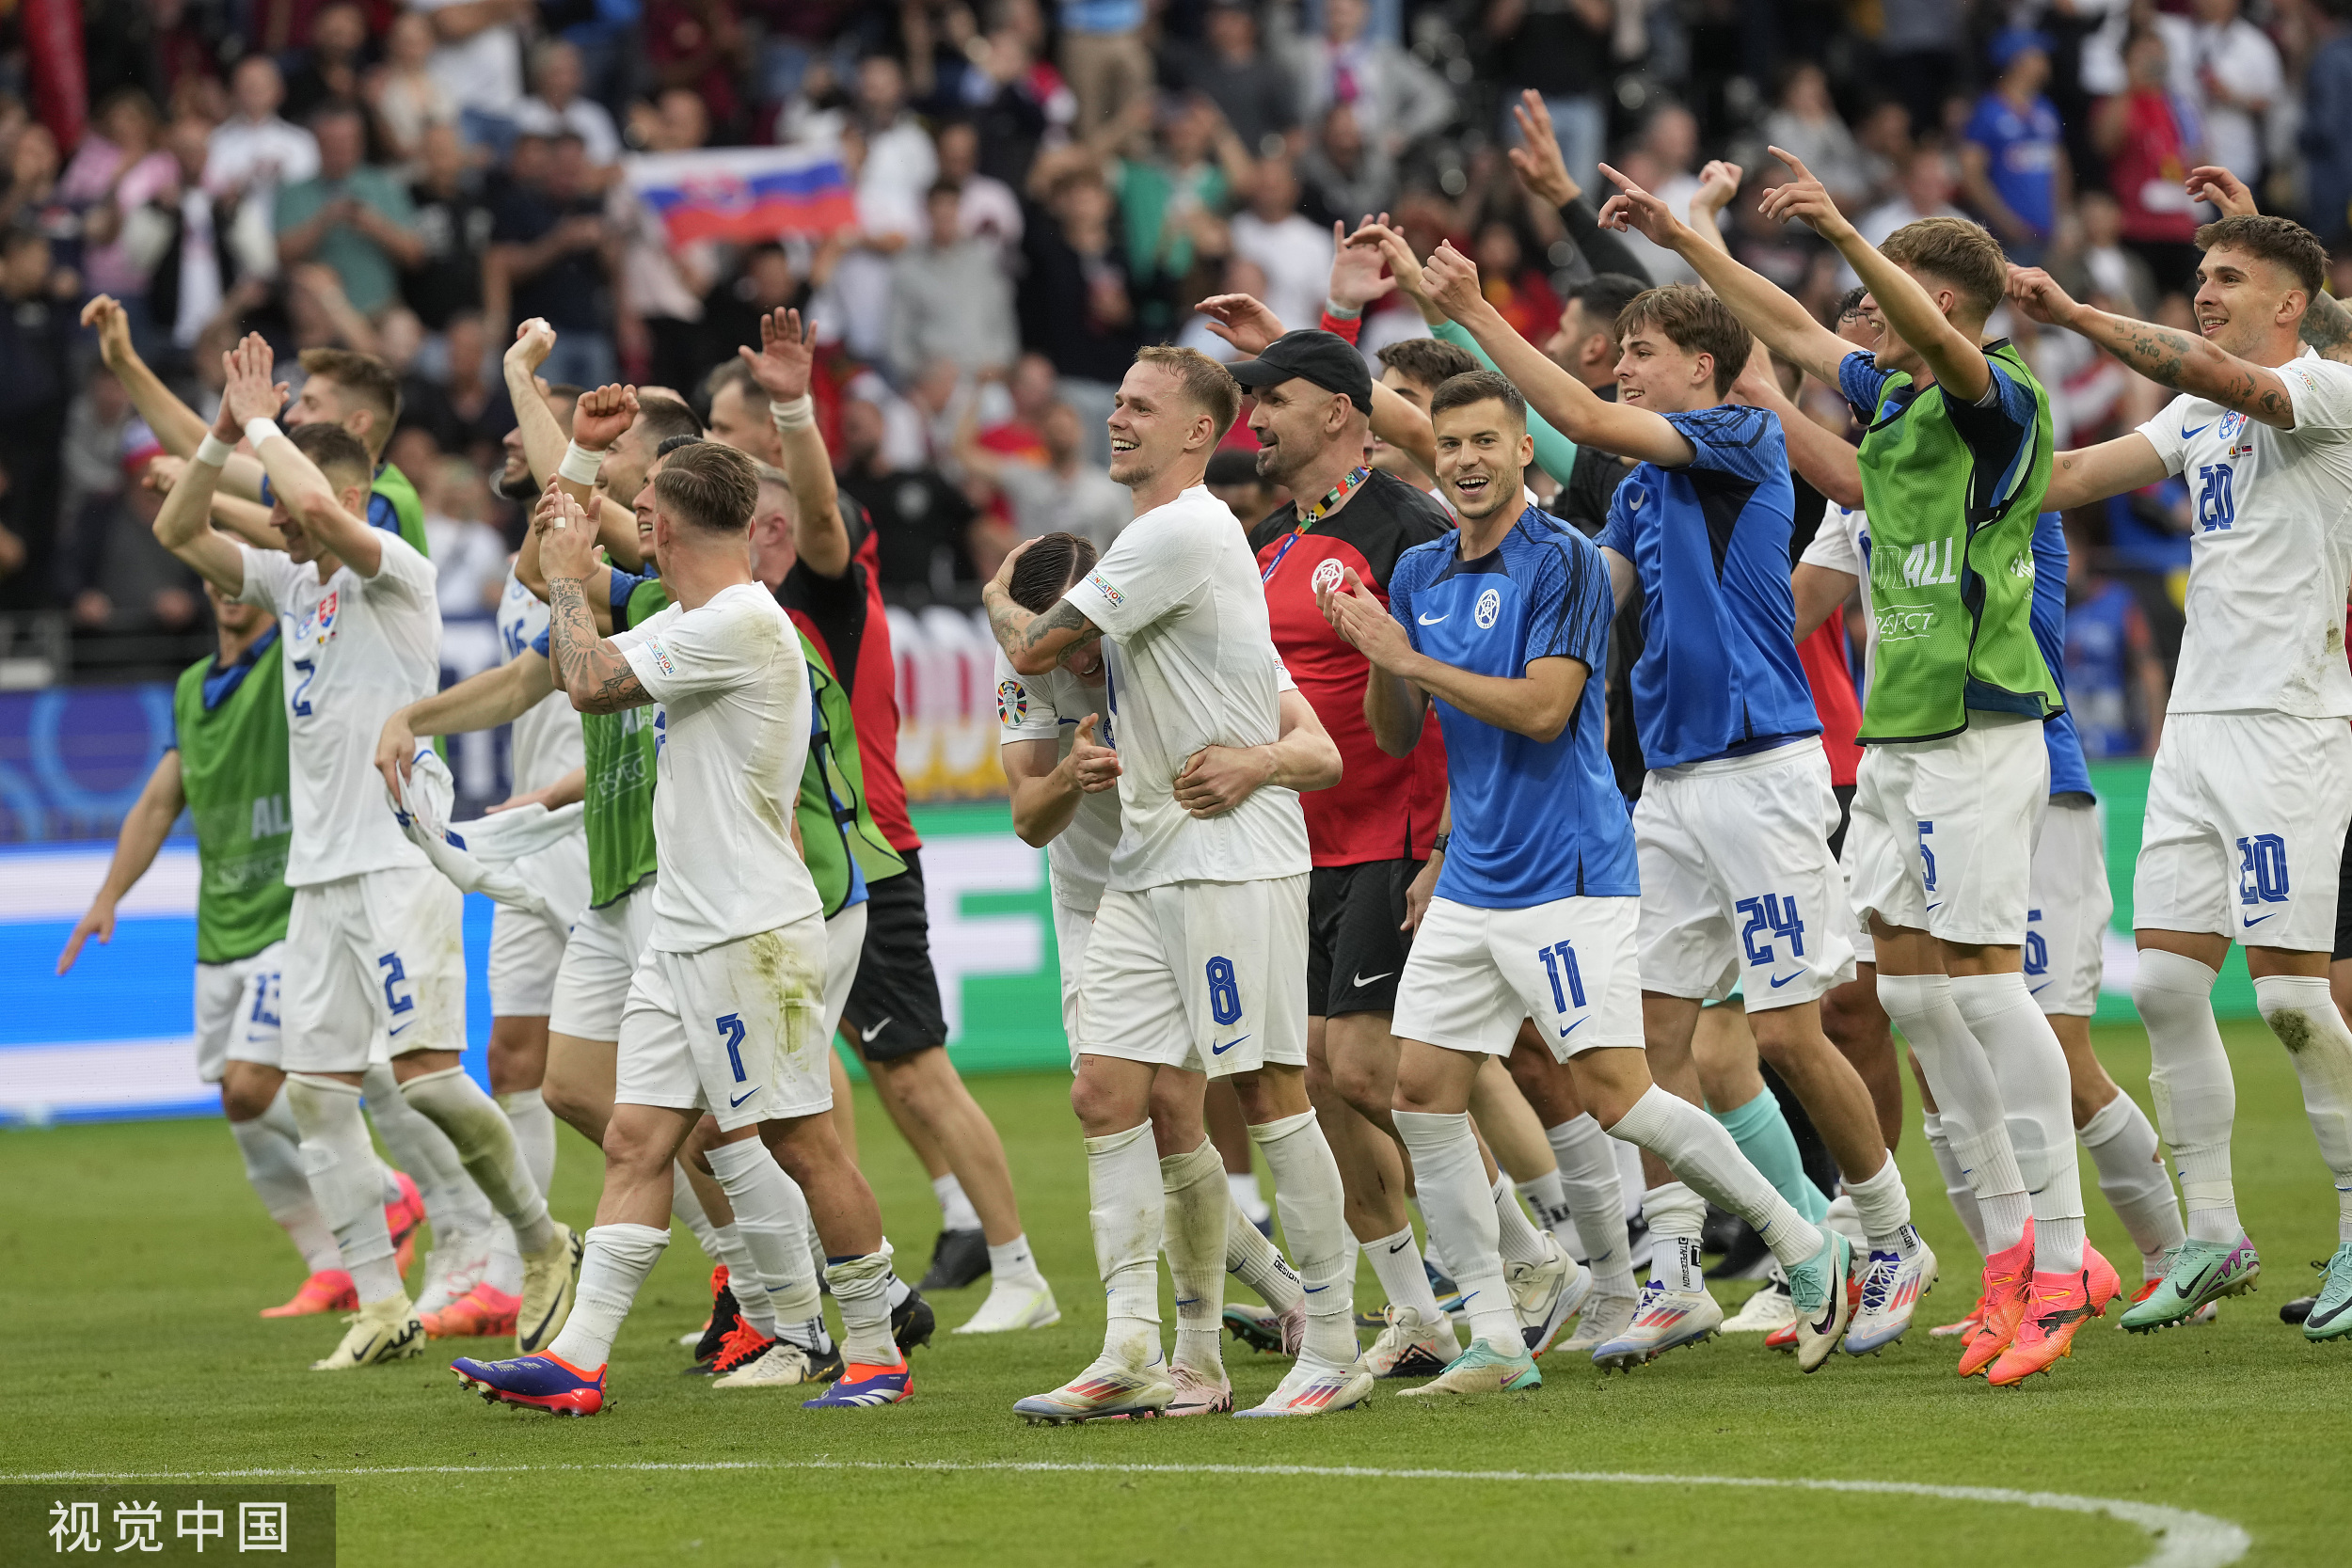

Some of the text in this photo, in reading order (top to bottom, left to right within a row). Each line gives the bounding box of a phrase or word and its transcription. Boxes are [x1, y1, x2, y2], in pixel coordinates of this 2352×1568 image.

[2199, 463, 2235, 532] 20
[293, 658, 315, 717] 2
[2235, 832, 2290, 906] 20
[1735, 893, 1804, 967] 24
[378, 951, 414, 1017] 2
[1205, 955, 1243, 1026] 8
[1538, 940, 1587, 1014] 11
[715, 1011, 747, 1084] 7
